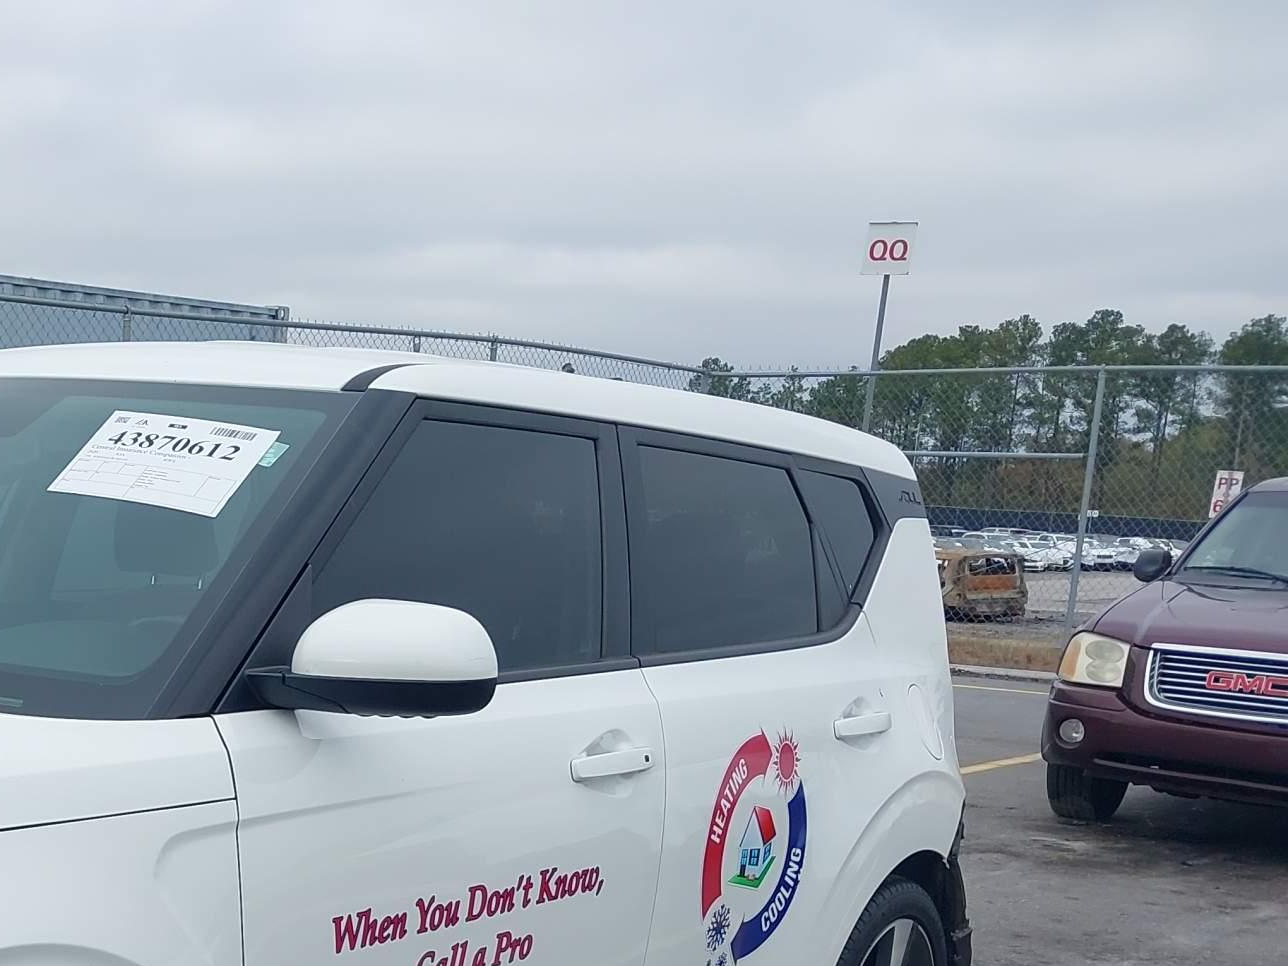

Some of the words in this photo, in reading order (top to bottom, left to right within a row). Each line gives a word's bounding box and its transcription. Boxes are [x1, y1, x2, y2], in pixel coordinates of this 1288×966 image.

[869, 239, 909, 261] QQ
[108, 430, 241, 461] 43870612
[1218, 477, 1240, 490] PP
[1205, 670, 1288, 696] GMC
[710, 758, 748, 844] HEATING
[761, 847, 802, 932] COOLING
[332, 908, 408, 954] When
[416, 895, 460, 935] You
[465, 874, 533, 923] Don't
[535, 866, 605, 905] Know,
